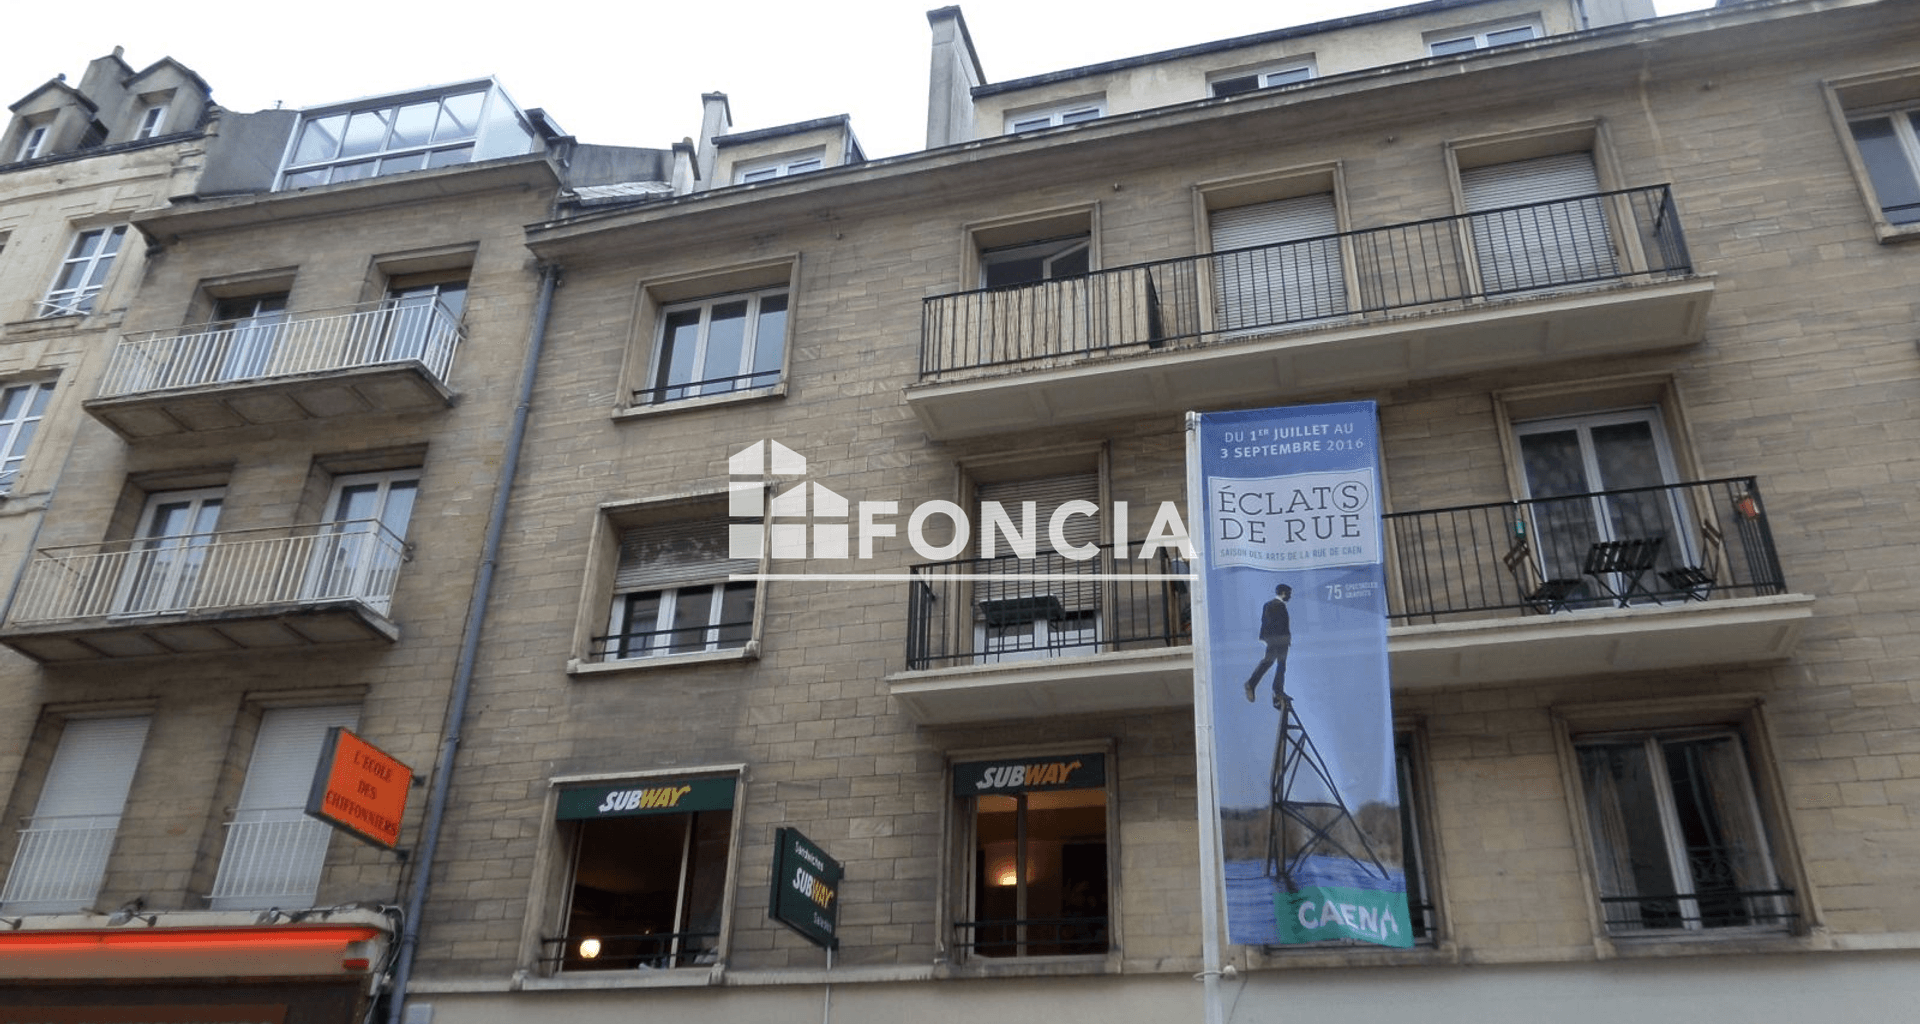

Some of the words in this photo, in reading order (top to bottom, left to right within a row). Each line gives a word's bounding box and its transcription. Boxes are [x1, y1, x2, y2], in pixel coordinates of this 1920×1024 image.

[1225, 431, 1244, 443] DU
[1274, 424, 1329, 441] JUILLET
[1334, 422, 1354, 434] AU
[1220, 448, 1229, 459] 3
[1233, 440, 1321, 458] SEPTEMBRE
[1326, 437, 1364, 451] 2016
[1218, 484, 1360, 515] ÉCLATS
[1219, 517, 1266, 544] DE
[1284, 514, 1361, 544] RUE
[1266, 552, 1286, 561] ARTS
[1287, 552, 1297, 561] DE
[1300, 550, 1310, 560] LA
[1312, 548, 1327, 558] RUE
[1329, 546, 1340, 556] DE
[1342, 545, 1363, 555] CAEN
[1325, 584, 1343, 601] 75
[975, 759, 1083, 790] SUBWAY
[357, 778, 378, 801] DES
[599, 784, 692, 813] SUBWAY
[326, 788, 397, 836] CHIFFONNIERS
[795, 841, 824, 872] Sandwiches
[792, 867, 834, 910] SUBWAY
